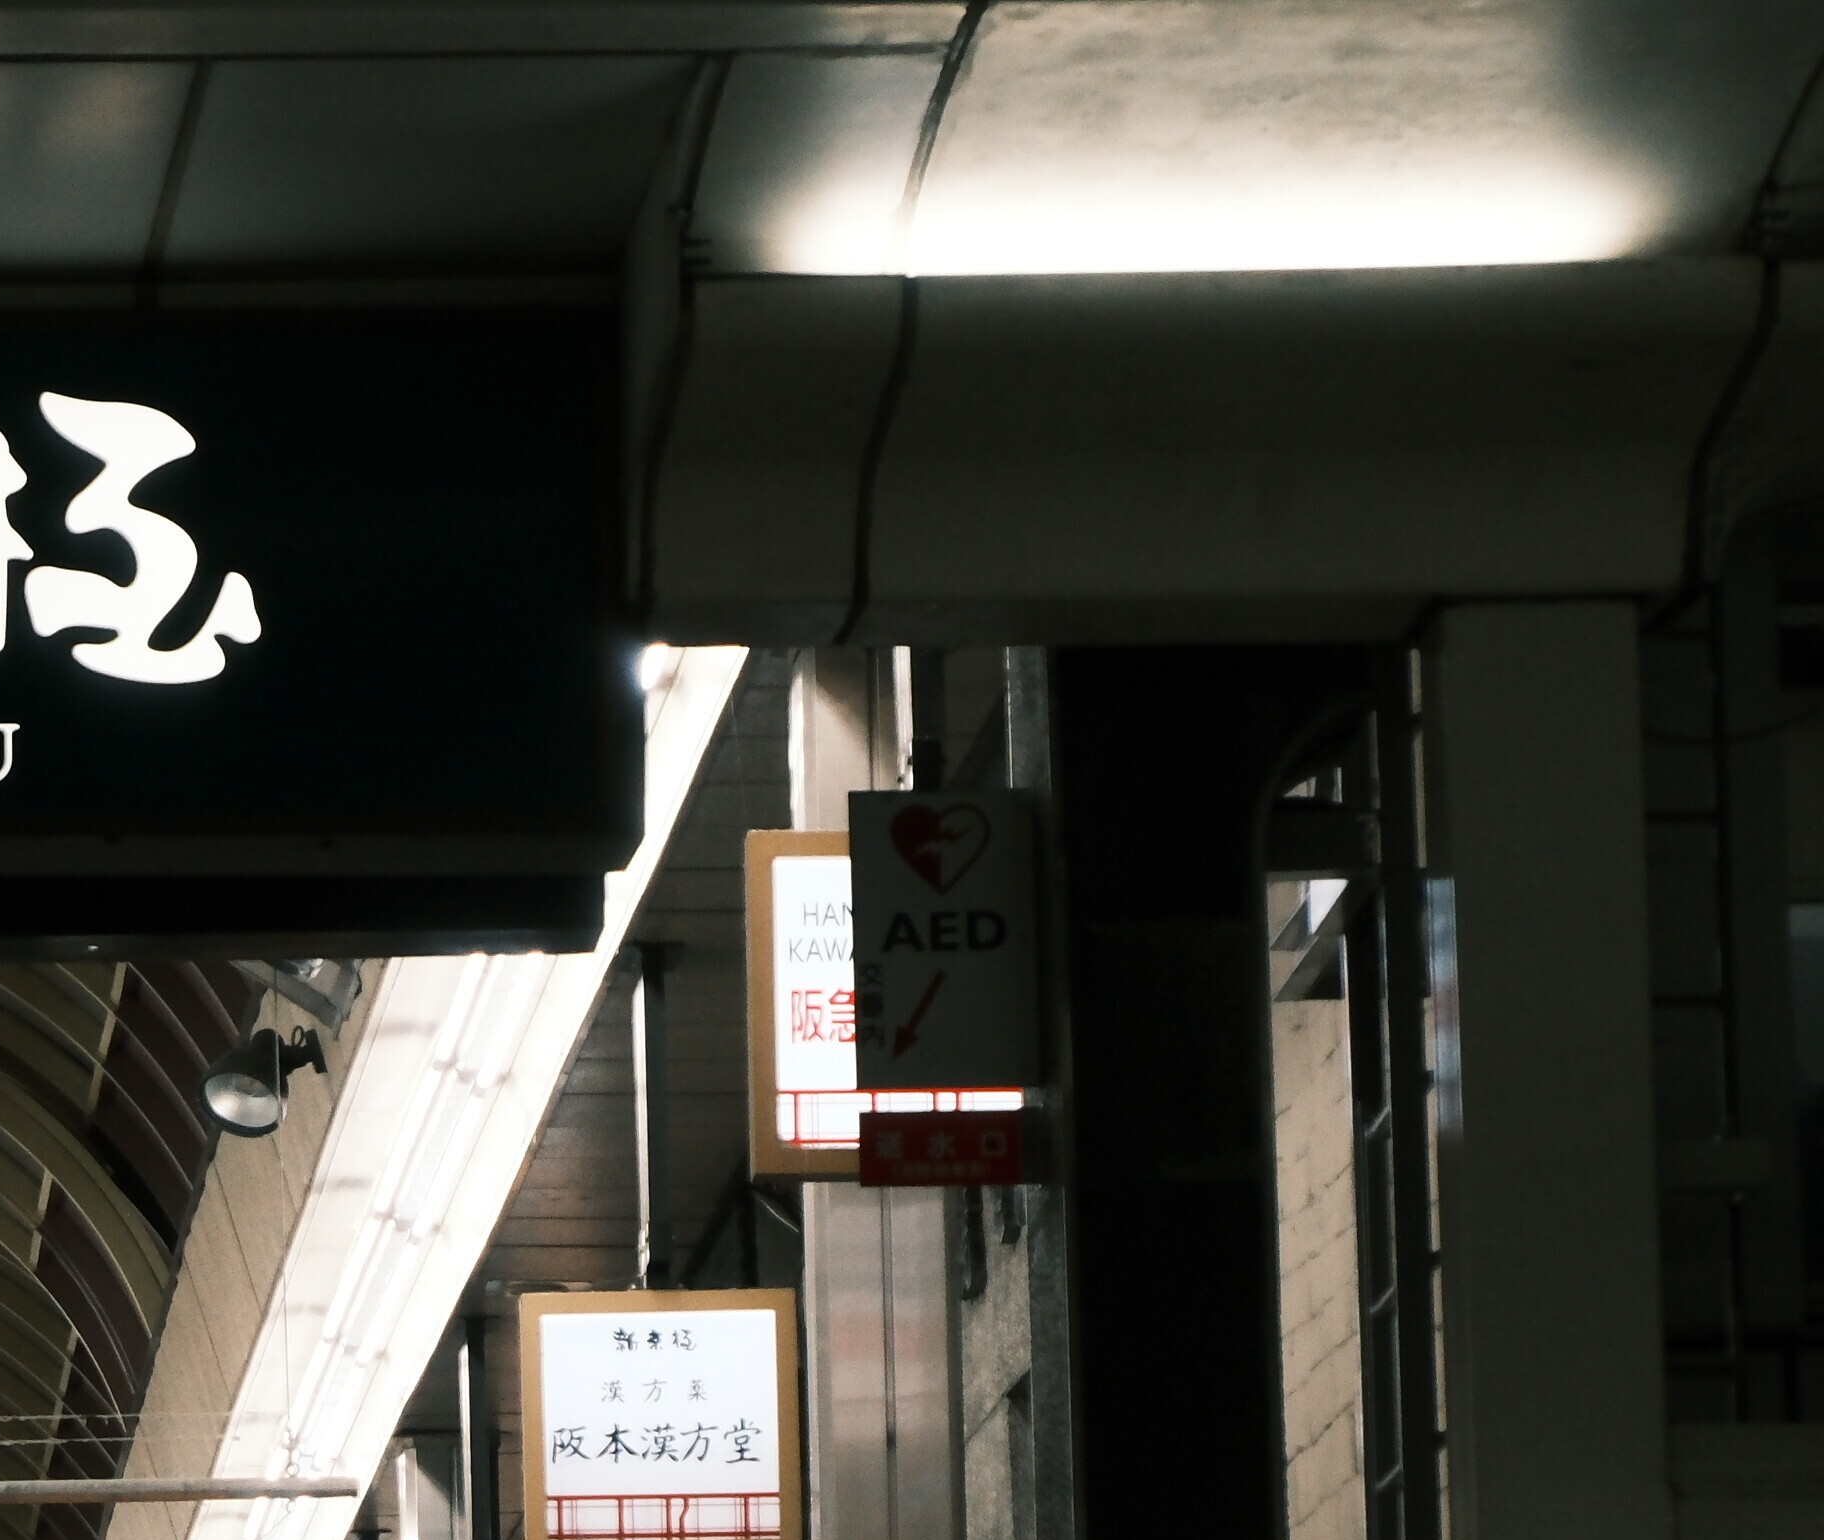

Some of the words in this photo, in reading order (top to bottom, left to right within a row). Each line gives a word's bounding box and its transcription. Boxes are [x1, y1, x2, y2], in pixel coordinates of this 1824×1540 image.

[881, 910, 1006, 953] AED
[789, 937, 855, 963] KAW
[601, 1378, 708, 1403] 漢方薬
[552, 1418, 763, 1463] 阪本漢方堂
